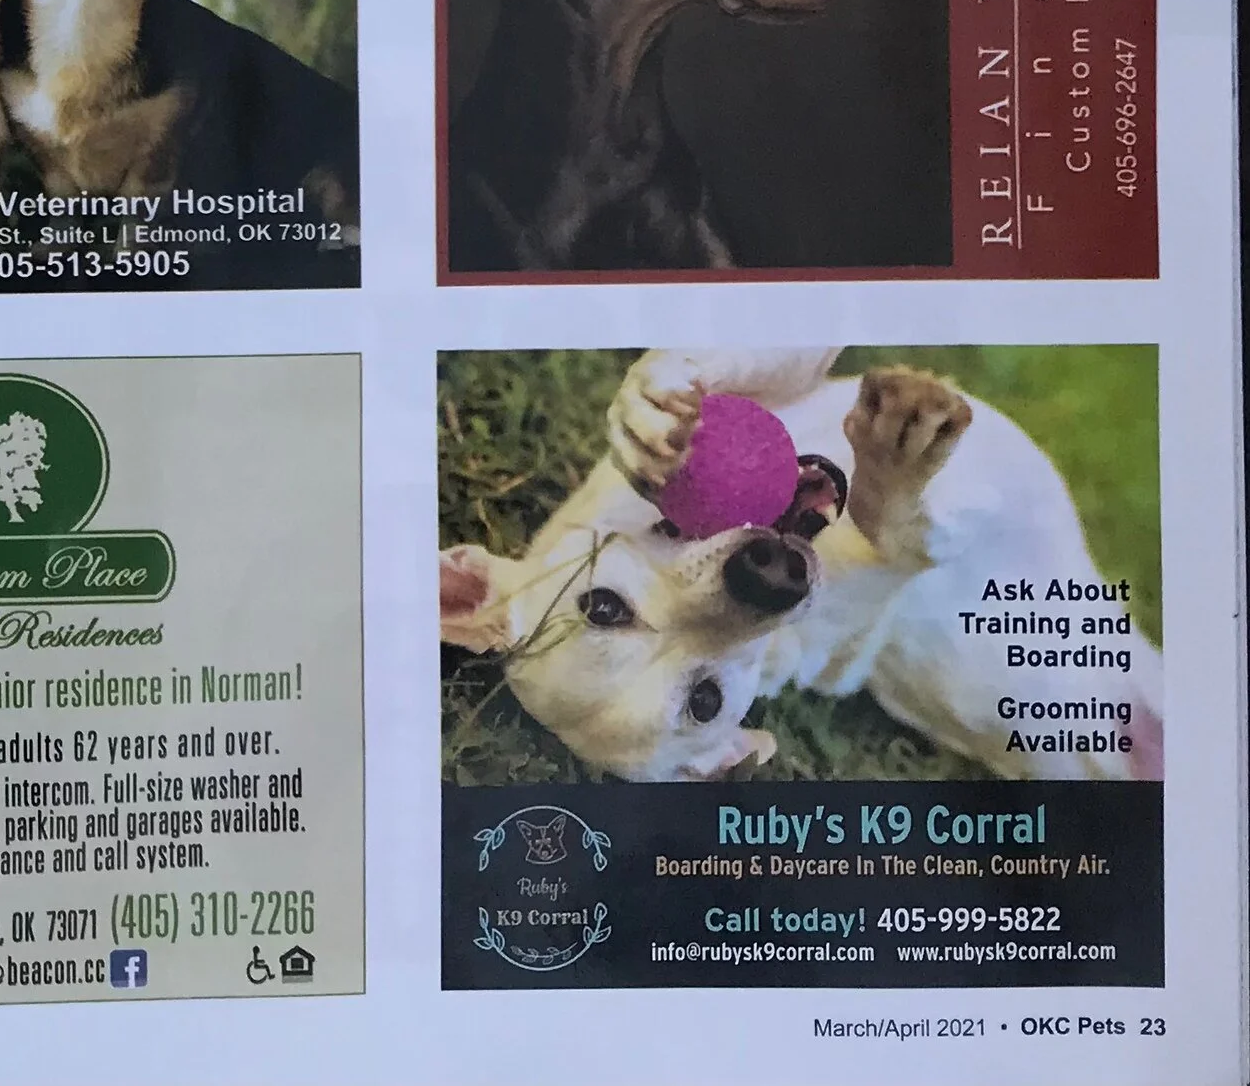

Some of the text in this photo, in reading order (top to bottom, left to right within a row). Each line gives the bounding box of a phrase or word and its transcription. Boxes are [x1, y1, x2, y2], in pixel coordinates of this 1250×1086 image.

[1066, 25, 1090, 172] Custom
[1116, 38, 1137, 197] 405-696-2647
[981, 46, 1013, 246] REIAN
[172, 188, 305, 216] Hospital
[39, 226, 94, 243] Suite
[100, 226, 115, 243] L
[135, 225, 232, 244] Edmond,
[239, 224, 273, 241] OK
[279, 222, 342, 240] 73012
[43, 545, 148, 590] Place
[982, 578, 1131, 602] Ask About
[959, 613, 1131, 639] Training and
[1007, 646, 1132, 673] Boarding
[46, 671, 160, 707] residence
[172, 669, 190, 704] in
[201, 663, 302, 703] Norman!
[998, 697, 1132, 725] Grooming
[73, 732, 98, 762] 62
[107, 734, 168, 766] years
[178, 730, 216, 758] and
[225, 731, 280, 756] over.
[1006, 730, 1133, 753] Available
[4, 779, 93, 807] intercom.
[103, 774, 182, 804] Full-size
[191, 772, 261, 801] washer
[268, 769, 302, 798] and
[5, 812, 78, 844] parking
[85, 811, 118, 838] and
[126, 811, 203, 840] garages
[211, 805, 305, 834] available.
[718, 805, 1046, 854] Ruby’s K9 Corral
[53, 845, 86, 874] and
[94, 843, 129, 873] call
[136, 843, 208, 874] system.
[656, 854, 1109, 881] Boarding & Daycare In The Clean, Country Air.
[12, 912, 35, 943] OK
[47, 909, 98, 941] 73071
[111, 889, 315, 944] (405) 310-2266
[497, 909, 588, 925] K9 Corral
[705, 907, 1061, 937] Call today! 405-999-5822
[651, 941, 1116, 964] info@rubysk9corral.com www.rubysk9corral.com
[814, 1017, 1166, 1042] March/April 2021 OKC Pets 23
